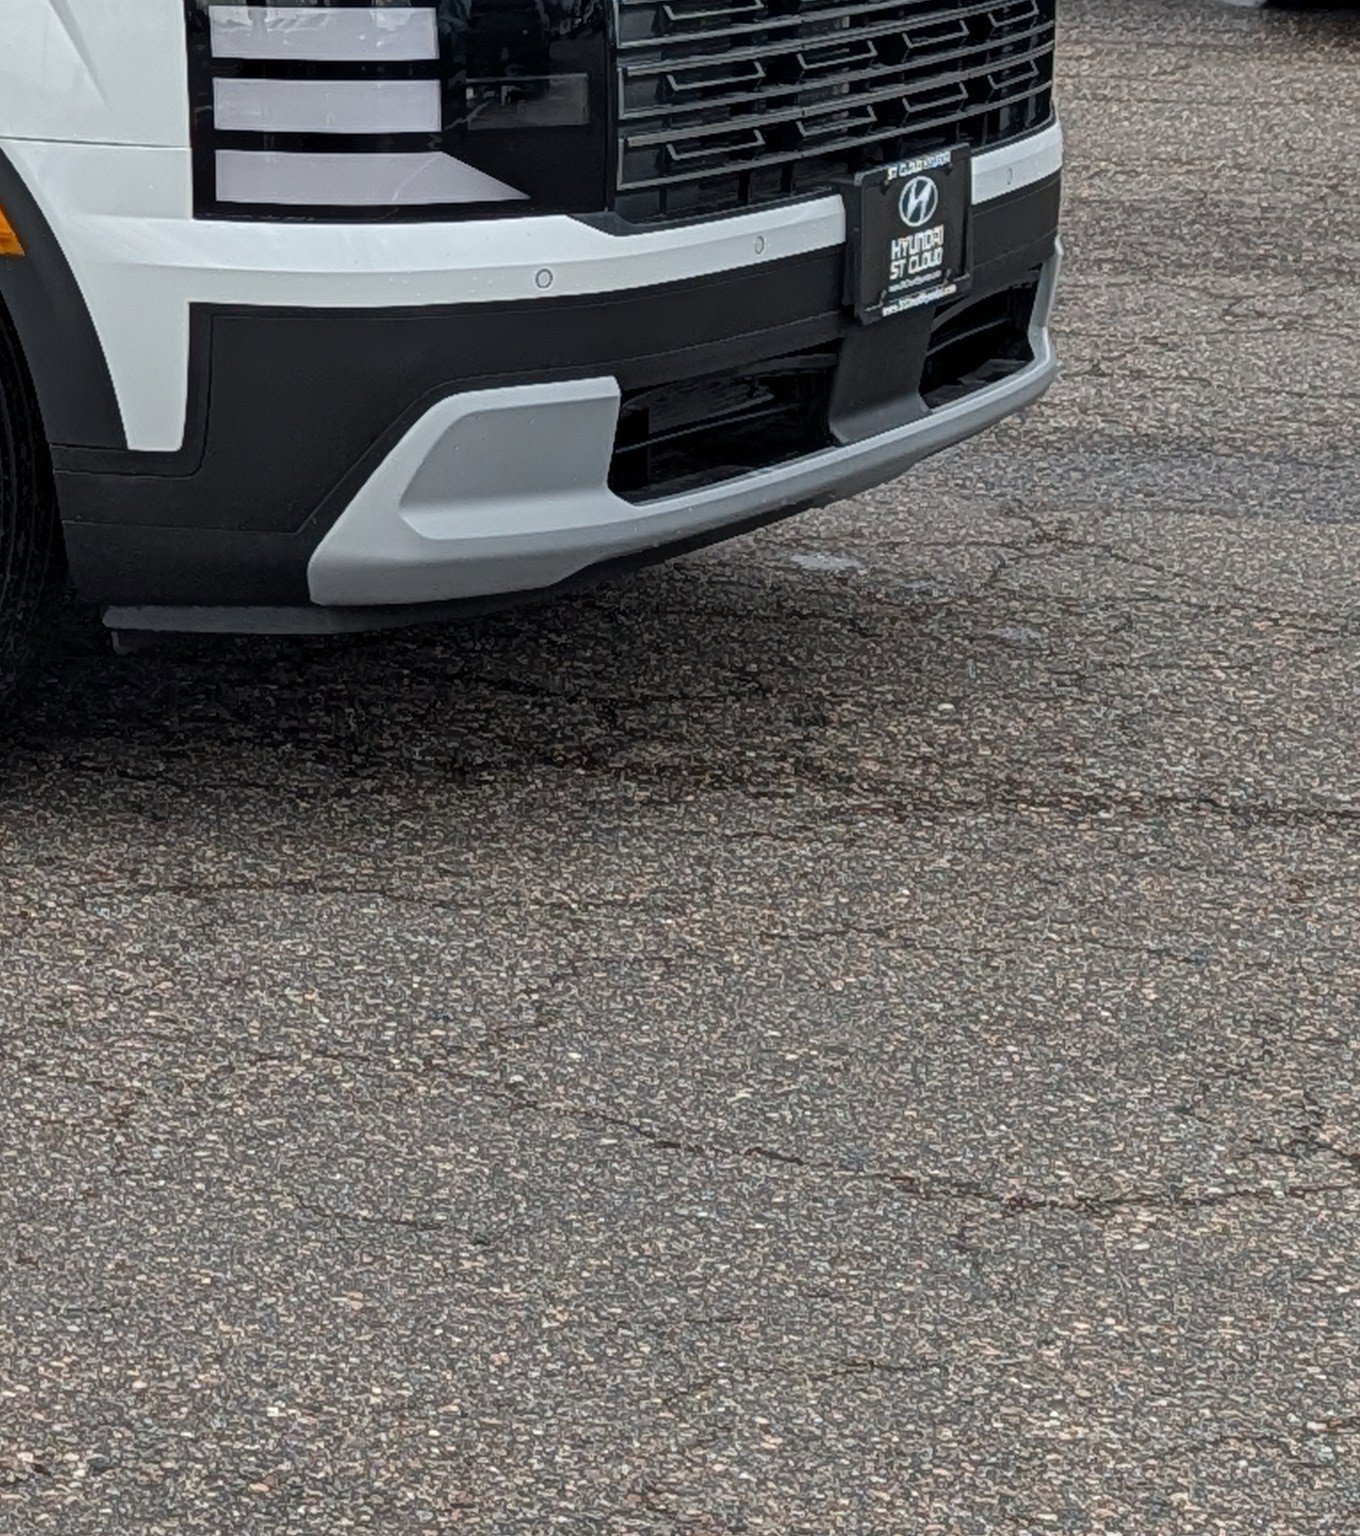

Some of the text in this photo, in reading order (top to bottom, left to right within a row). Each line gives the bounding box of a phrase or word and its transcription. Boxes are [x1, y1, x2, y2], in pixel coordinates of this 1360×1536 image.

[891, 224, 944, 260] HYUNDAI
[889, 246, 944, 280] ST CLOUD
